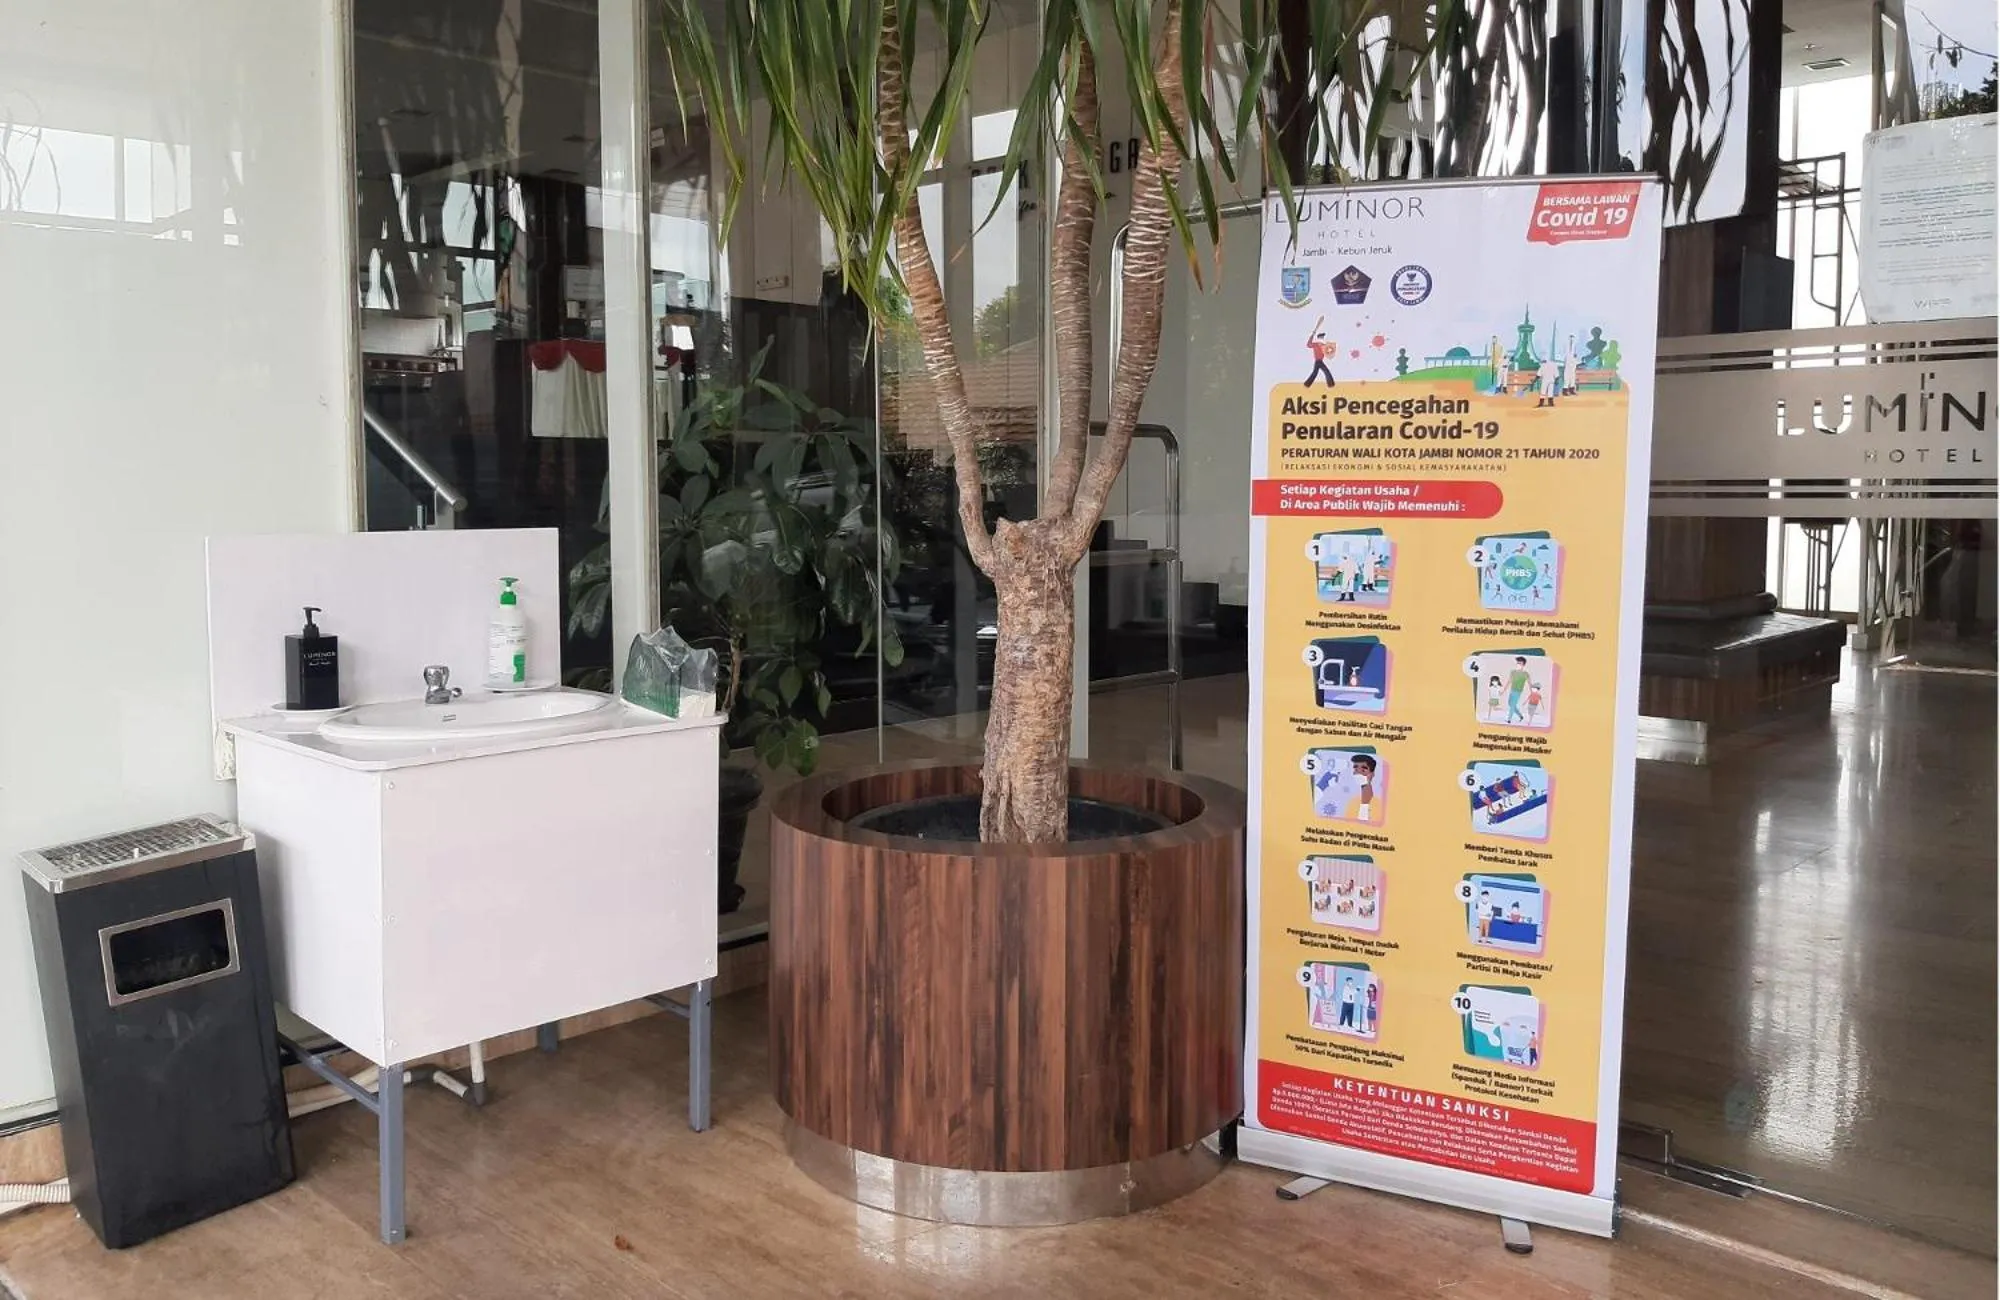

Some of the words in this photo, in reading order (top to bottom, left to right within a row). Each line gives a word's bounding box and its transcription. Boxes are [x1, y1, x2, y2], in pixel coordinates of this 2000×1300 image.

[1543, 196, 1591, 206] BERSAMA
[1593, 194, 1631, 204] LAWAN
[1275, 193, 1425, 224] LUMINOR
[1536, 205, 1599, 227] Covid
[1603, 207, 1628, 225] 19
[1318, 230, 1376, 239] HOTEL
[1302, 247, 1327, 257] Jambi
[1337, 246, 1366, 256] Kebun
[1369, 245, 1393, 255] Jeruk
[1281, 394, 1328, 415] Aksi
[1333, 394, 1470, 419] Pencegahan
[1776, 372, 1997, 436] LUMIN
[1282, 421, 1393, 440] Penularan
[1399, 419, 1500, 440] Covid-19
[1281, 448, 1349, 459] PERATURAN
[1352, 448, 1381, 459] WALI
[1384, 448, 1416, 459] KOTA
[1419, 448, 1453, 460] JAMBI
[1456, 448, 1503, 459] NOMOR
[1505, 448, 1520, 459] 21
[1523, 448, 1565, 459] TAHUN
[1568, 448, 1600, 459] 2020
[1864, 448, 1983, 463] HOTEL
[1333, 463, 1374, 471] EKONOMI
[1386, 463, 1416, 471] SOSIAL
[1280, 485, 1316, 497] Setiap
[1319, 485, 1371, 497] Kegiatan
[1374, 486, 1410, 495] Usaha
[1280, 499, 1291, 509] Di
[1294, 500, 1320, 510] Area
[1323, 500, 1359, 510] Publik
[1362, 501, 1395, 512] Wajib
[1398, 501, 1459, 512] Memenuhi
[1312, 544, 1320, 556] 1
[1474, 550, 1483, 562] 2
[1504, 568, 1532, 578] PHBS
[1319, 612, 1366, 620] Pembersihan
[1368, 613, 1387, 621] Rutin
[1305, 620, 1355, 630] Menggunakan
[1456, 618, 1503, 626] Memastikan
[1505, 620, 1535, 628] Pekerja
[1536, 621, 1579, 629] Memahami
[1442, 627, 1473, 635] Perilaku
[1474, 628, 1498, 637] Hidup
[1499, 629, 1524, 637] Bersih
[1526, 630, 1541, 638] dan
[1542, 631, 1565, 639] Sehat
[1308, 650, 1317, 661] 3
[1470, 661, 1479, 672] 4
[1289, 717, 1336, 727] Menyediakan
[1338, 720, 1367, 729] Fasilitas
[1386, 724, 1413, 733] Tangan
[1296, 726, 1323, 736] dengan
[1324, 728, 1346, 736] Sabun
[1348, 730, 1362, 738] dan
[1374, 732, 1407, 742] Mengalir
[1478, 732, 1524, 745] Pengunjung
[1525, 737, 1547, 746] Wajib
[1473, 742, 1521, 752] Mengenakan
[1523, 746, 1552, 755] Masker
[1306, 759, 1315, 770] 5
[1466, 775, 1475, 786] 6
[1306, 827, 1344, 838] Melakukan
[1320, 837, 1342, 846] Badan
[1352, 841, 1370, 850] Pintu
[1372, 843, 1395, 852] Masuk
[1464, 844, 1498, 854] Memberi
[1500, 847, 1523, 857] Tanda
[1524, 850, 1553, 860] Khusus
[1478, 854, 1515, 865] Pembatas
[1517, 858, 1538, 868] Jarak
[1305, 864, 1313, 876] 7
[1462, 885, 1471, 898] 8
[1287, 928, 1327, 940] Pengaturan
[1348, 936, 1374, 946] Tempat
[1376, 940, 1399, 949] Duduk
[1300, 939, 1328, 949] Berjarak
[1330, 943, 1357, 954] Minimal
[1364, 948, 1385, 958] Meter
[1456, 952, 1509, 966] Menggunakan
[1302, 971, 1311, 982] 9
[1467, 963, 1491, 973] Partisi
[1493, 967, 1501, 975] Di
[1502, 968, 1521, 978] Meja
[1522, 971, 1542, 980] Kasir
[1454, 997, 1471, 1009] 10
[1295, 1045, 1310, 1054] 50%
[1311, 1048, 1326, 1057] Dari
[1326, 1050, 1361, 1063] Kapasitas
[1362, 1057, 1393, 1069] Tersedia
[1329, 1042, 1370, 1057] Pengunjung
[1371, 1050, 1404, 1062] Maksimal
[1453, 1064, 1492, 1078] Memasang
[1494, 1071, 1517, 1081] Media
[1518, 1075, 1555, 1087] Informasi
[1499, 1091, 1539, 1104] Kesehatan
[1526, 1086, 1553, 1097] Terkait
[1334, 1078, 1436, 1108] KETENTUAN
[1442, 1098, 1509, 1122] SANKSI
